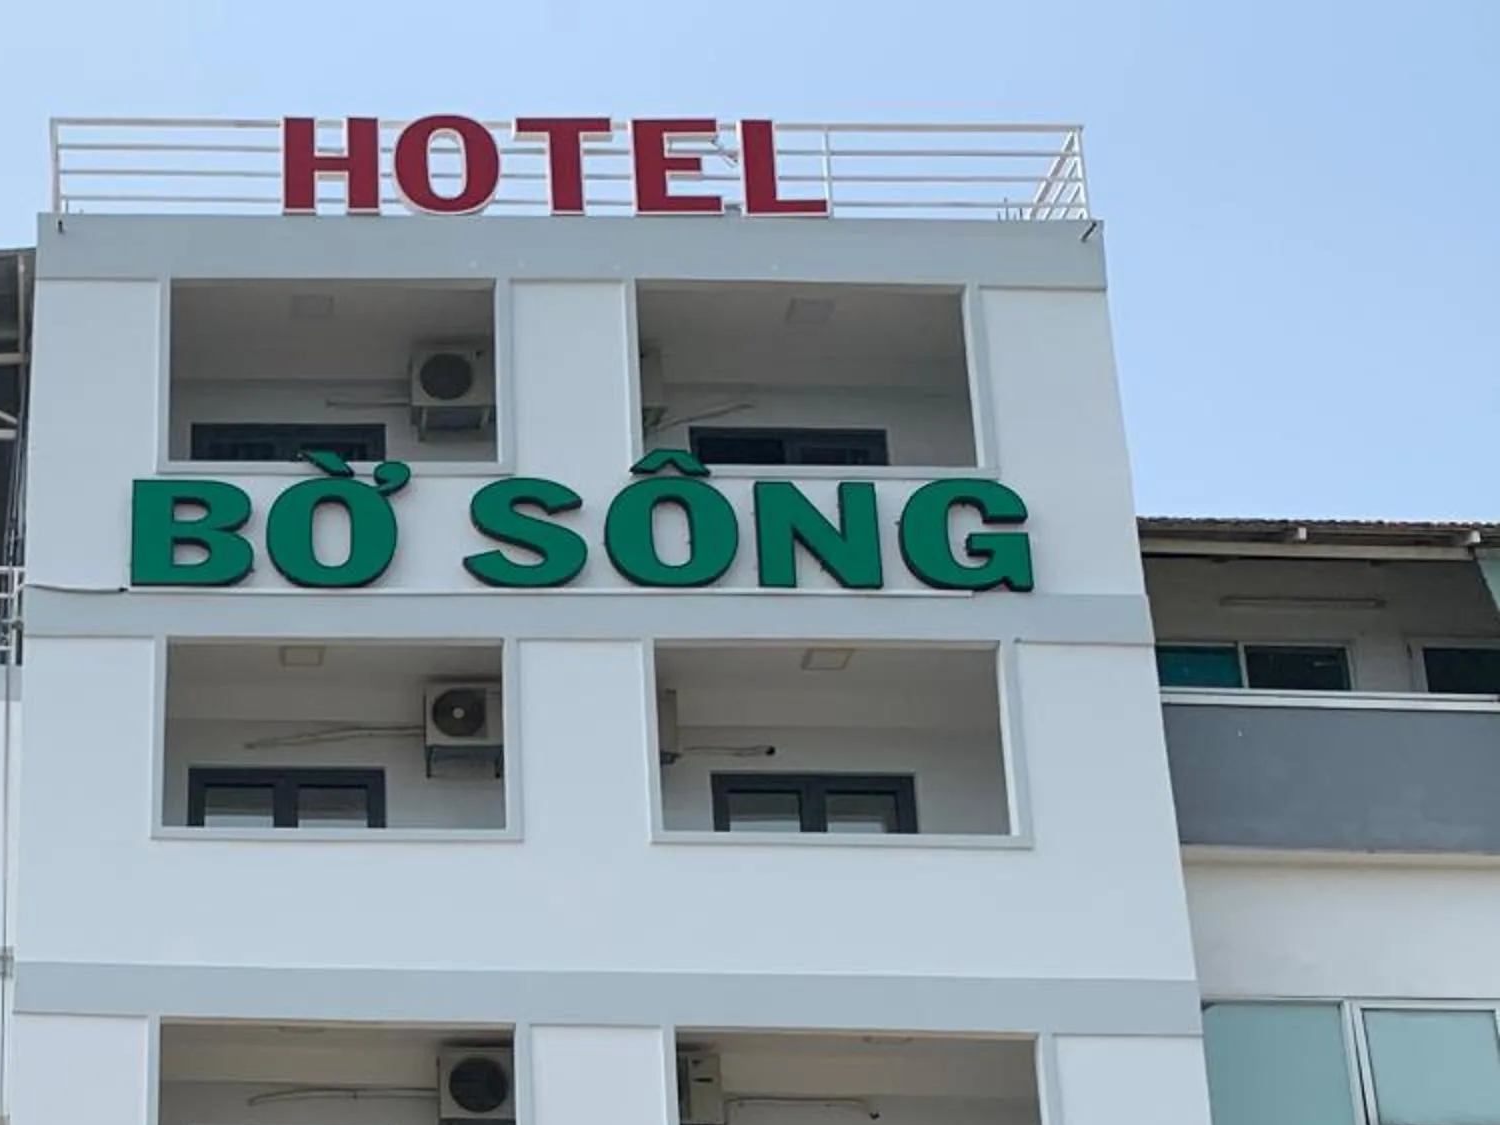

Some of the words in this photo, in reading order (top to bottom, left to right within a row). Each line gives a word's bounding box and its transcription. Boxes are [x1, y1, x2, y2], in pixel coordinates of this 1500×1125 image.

[283, 113, 830, 217] HOTEL
[130, 450, 412, 588] BỜ
[462, 448, 1035, 592] SÔNG
